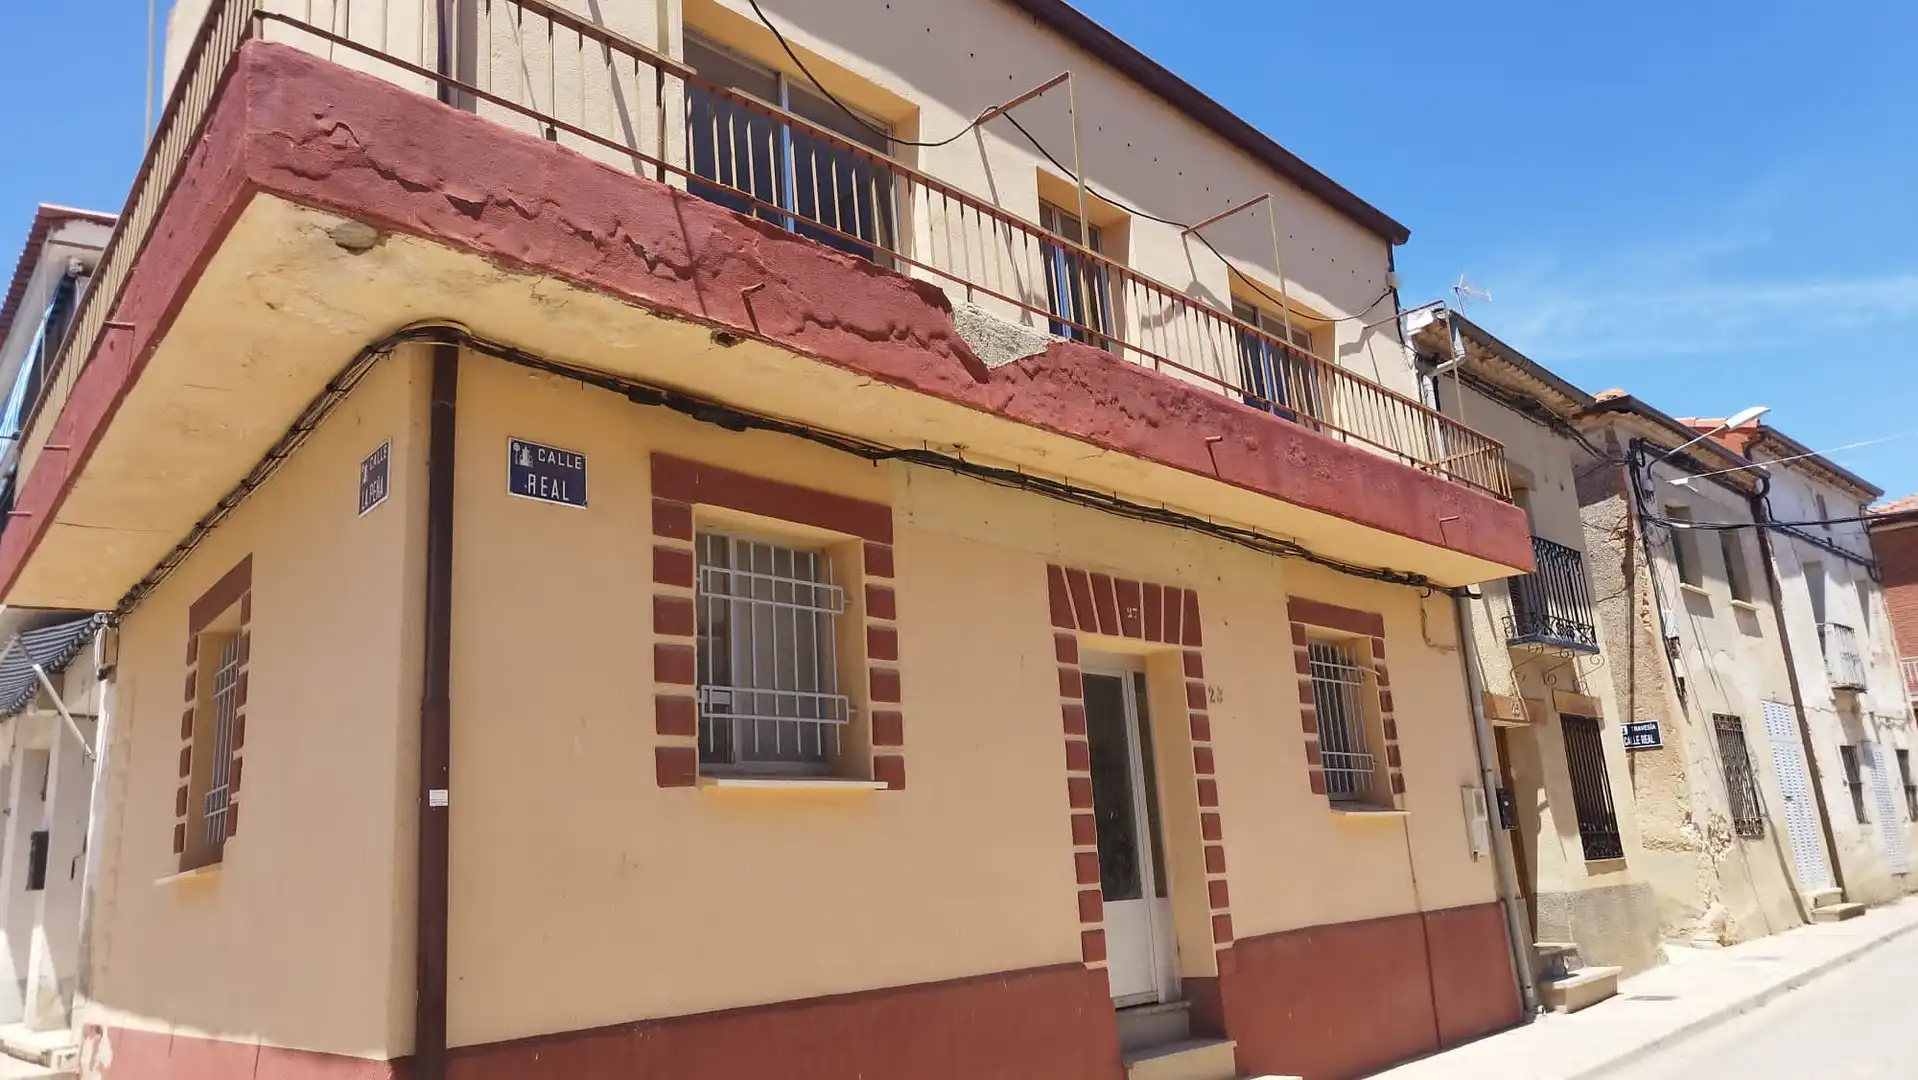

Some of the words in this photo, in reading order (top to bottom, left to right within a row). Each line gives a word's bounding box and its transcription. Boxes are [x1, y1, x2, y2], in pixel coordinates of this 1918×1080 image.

[369, 445, 387, 470] CALLE
[538, 449, 582, 469] CALLE
[527, 473, 569, 501] REAL
[1641, 734, 1655, 744] REAL
